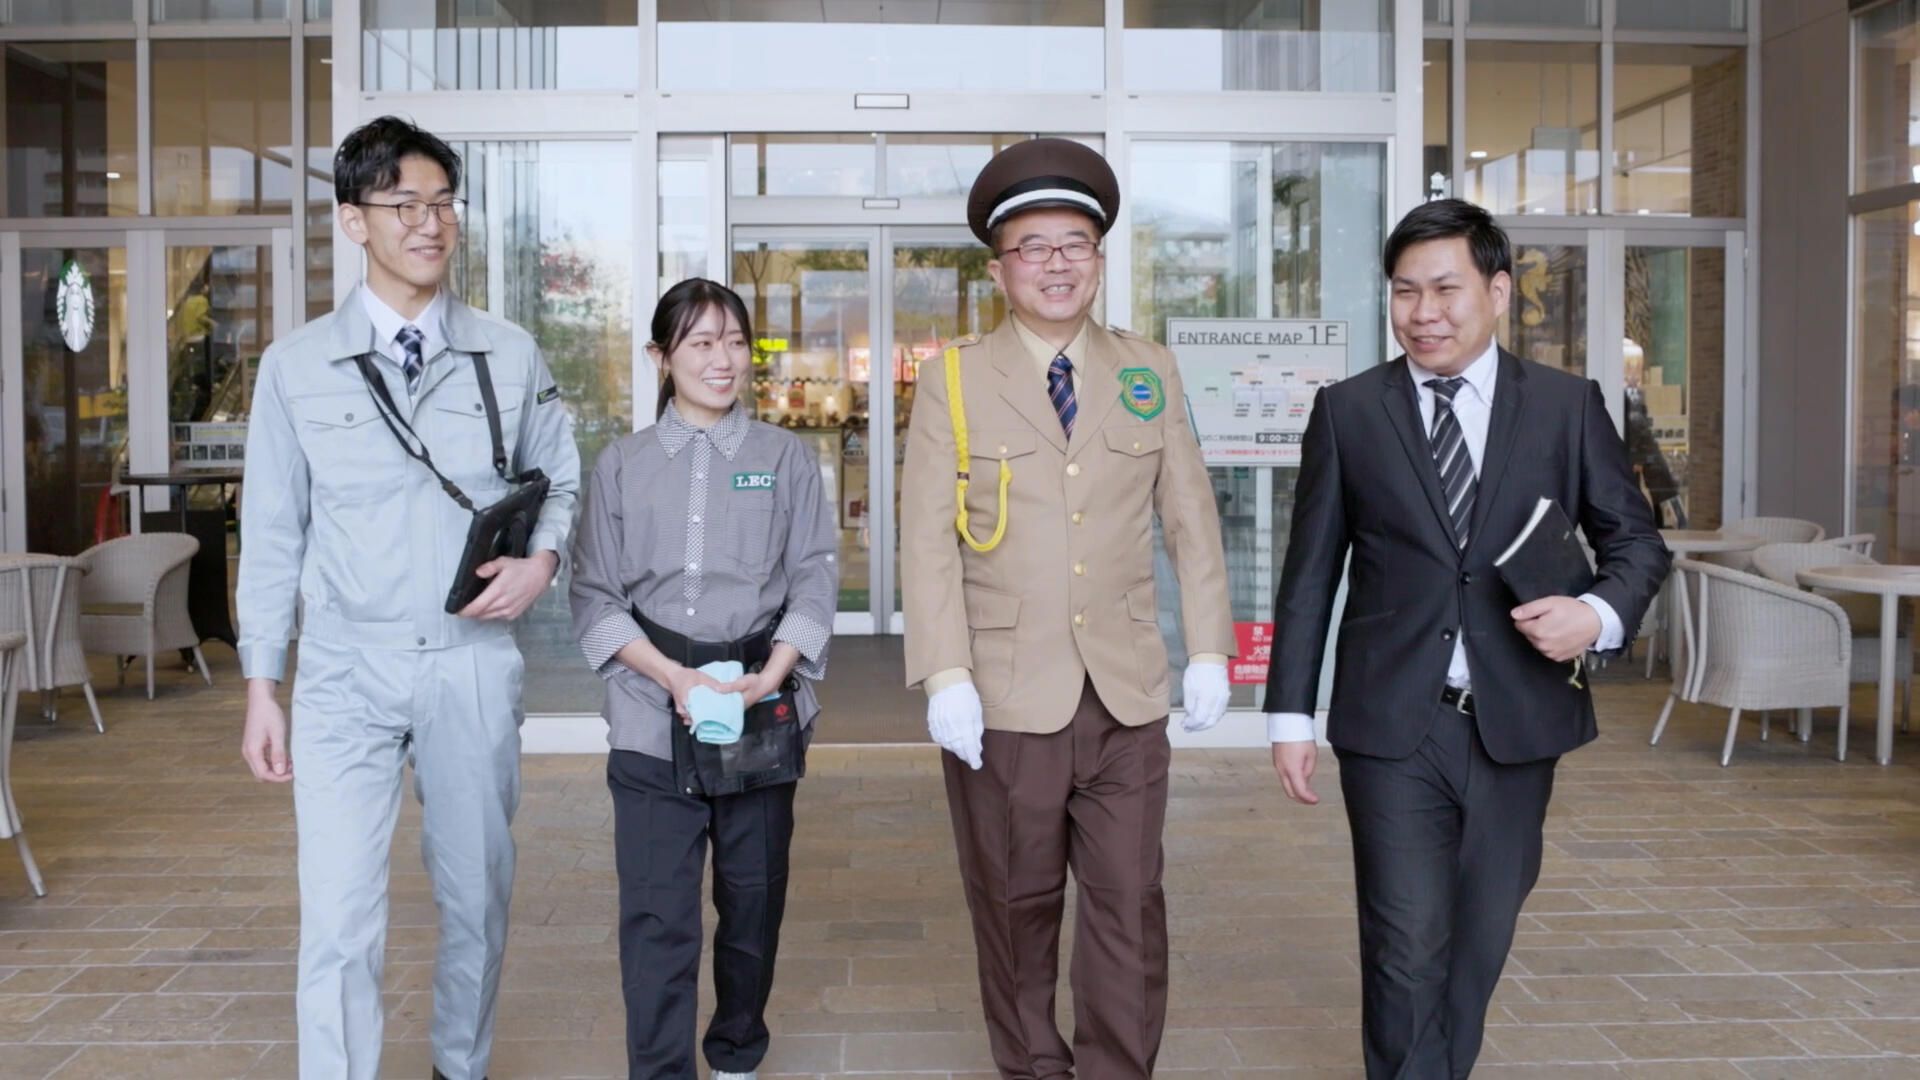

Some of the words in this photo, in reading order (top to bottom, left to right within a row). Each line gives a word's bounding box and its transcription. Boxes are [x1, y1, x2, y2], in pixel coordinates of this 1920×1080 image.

[1177, 331, 1263, 345] ENTRANCE
[1268, 331, 1303, 345] MAP
[1308, 324, 1339, 345] 1F
[735, 474, 776, 487] LEC
